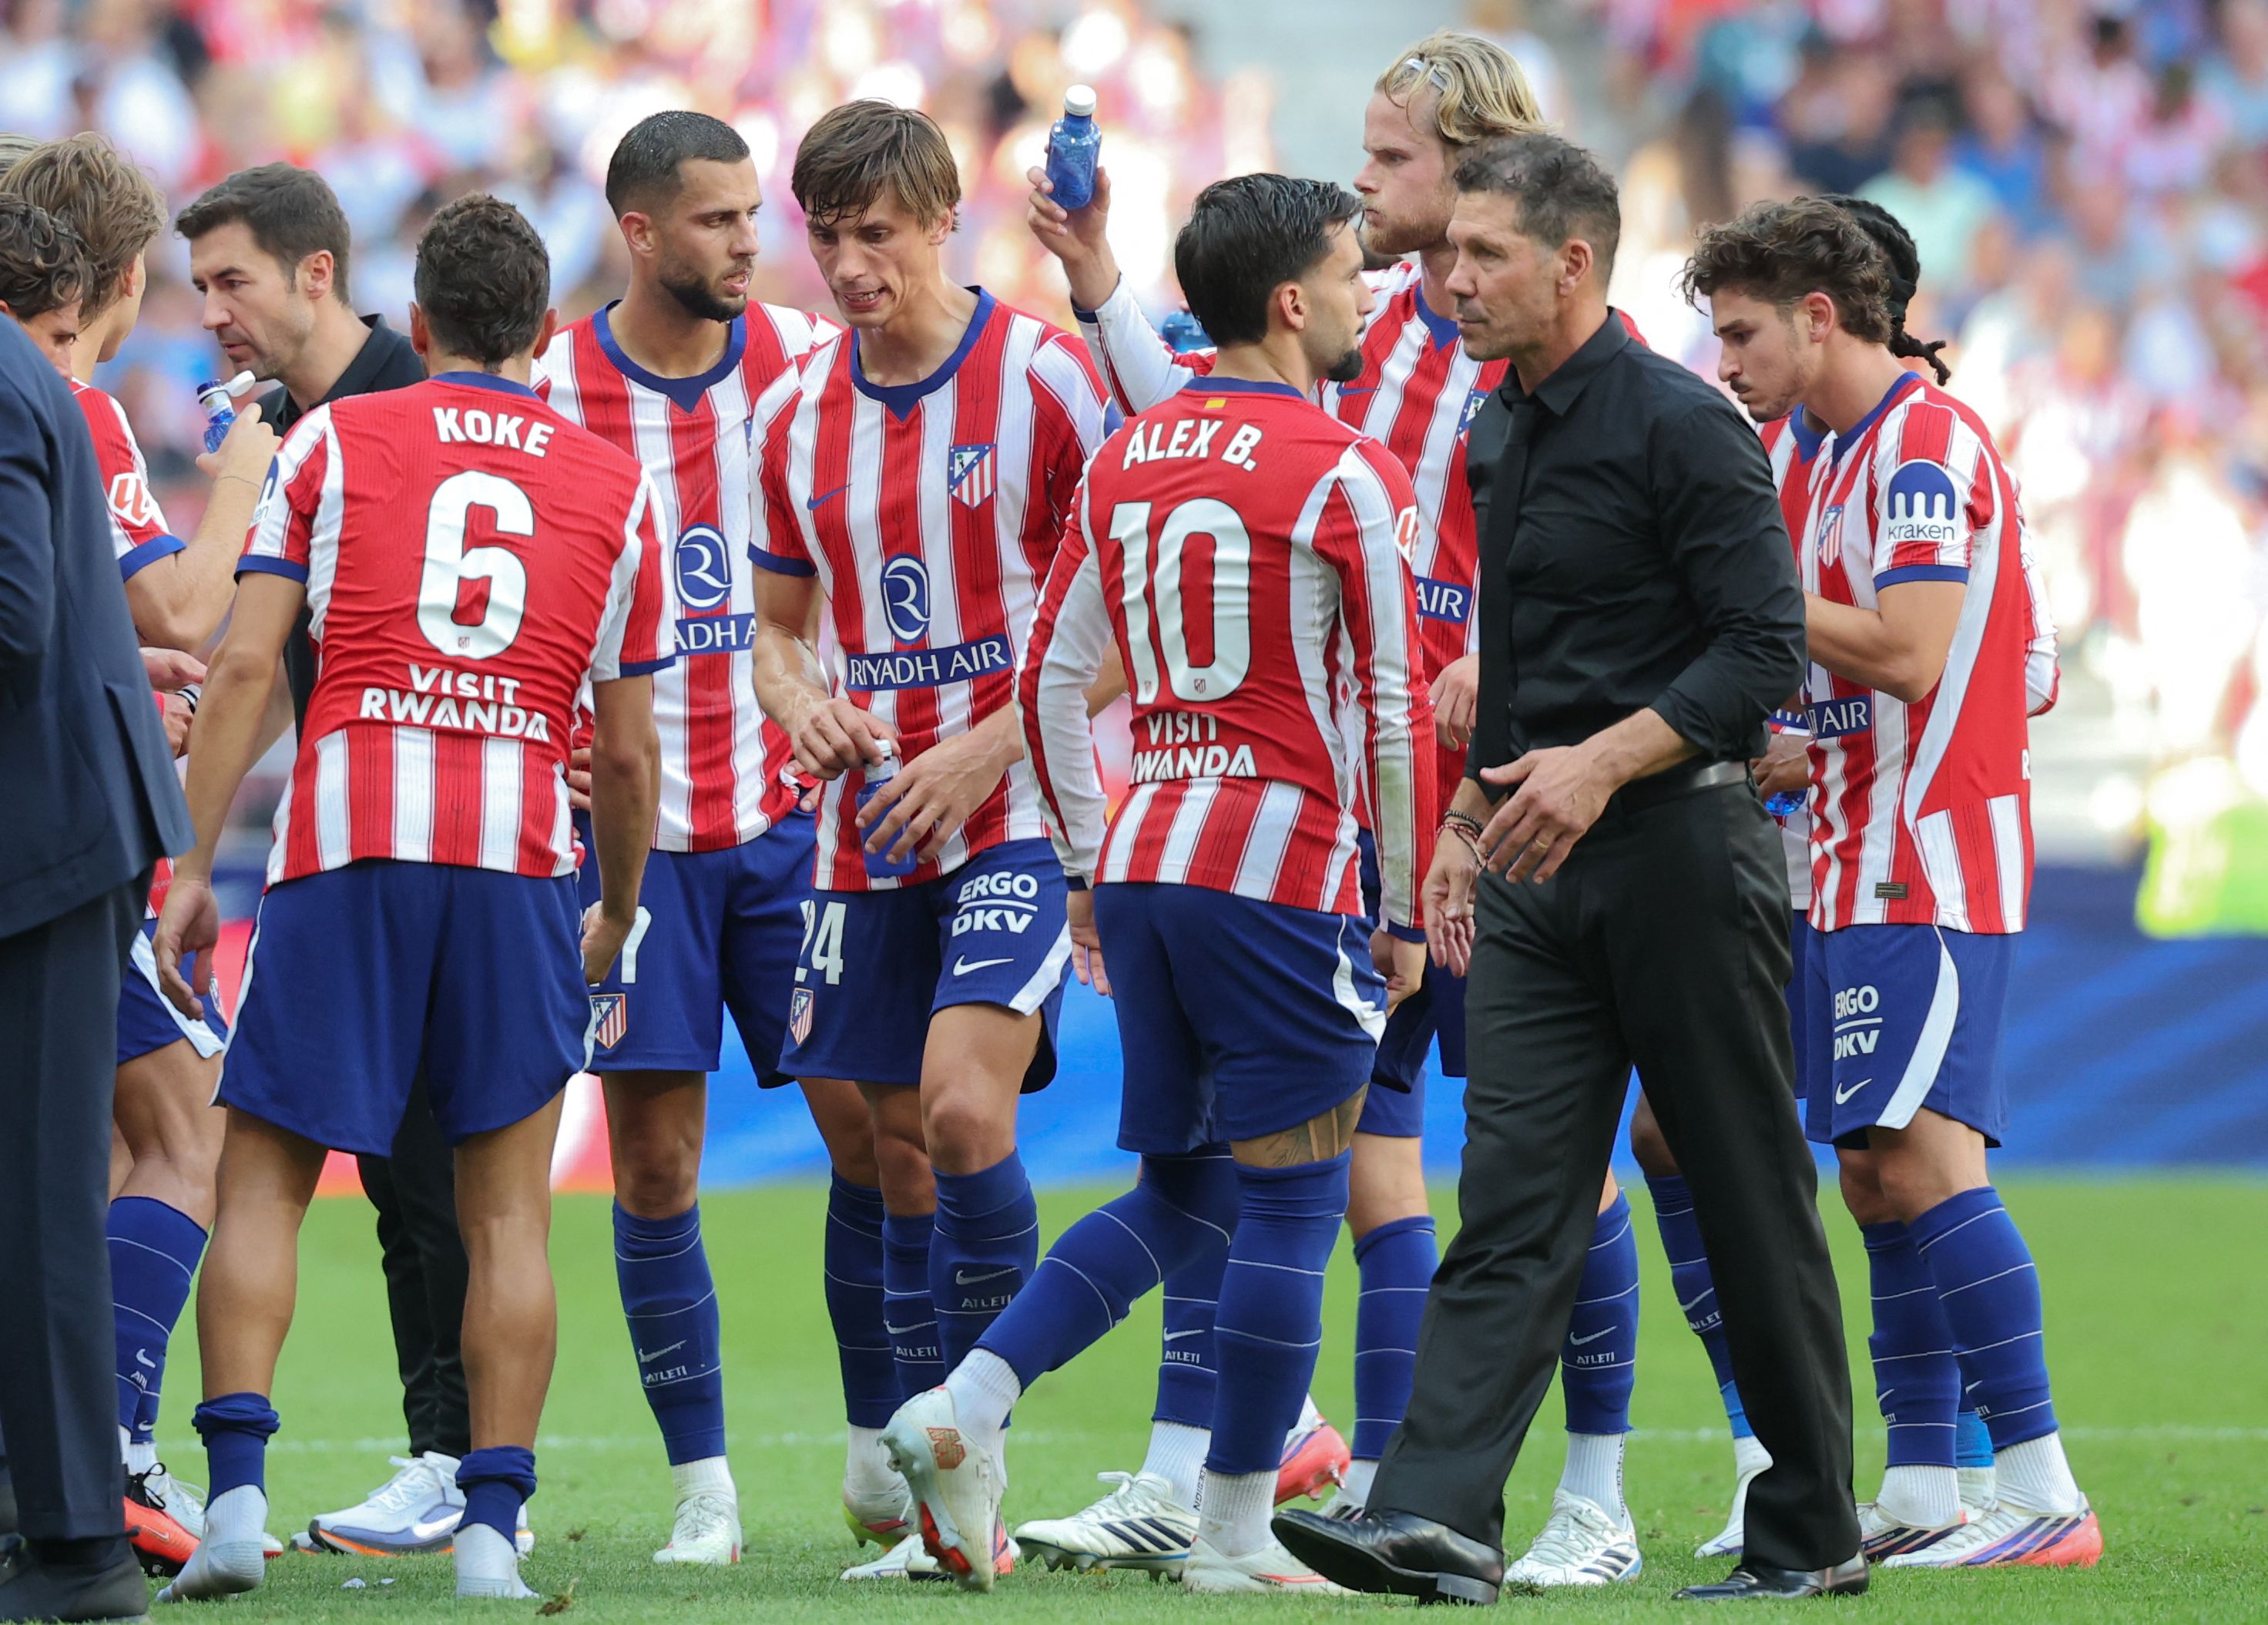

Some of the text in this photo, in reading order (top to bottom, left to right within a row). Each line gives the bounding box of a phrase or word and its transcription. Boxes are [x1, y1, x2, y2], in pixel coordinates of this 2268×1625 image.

[432, 407, 555, 458] KOKE
[1122, 418, 1263, 472] ÁLEX B.
[1887, 524, 1954, 540] kraken
[416, 469, 535, 660] 6
[1109, 497, 1251, 704] 10
[1416, 582, 1463, 619] AIR
[675, 619, 737, 650] ADH
[850, 640, 1007, 686] RIYADH AIR
[408, 663, 521, 706] VISIT
[359, 687, 550, 743] RWANDA
[1146, 710, 1217, 746] VISIT
[1822, 701, 1867, 733] AIR
[1130, 744, 1257, 784] WANDA
[957, 871, 1038, 903] ERGO
[951, 909, 1033, 937] DKV
[1835, 985, 1879, 1020] ERGO
[1834, 1029, 1880, 1061] DKV
[961, 1294, 1012, 1308] ATLETI
[1689, 1310, 1721, 1329] ATLET
[896, 1346, 938, 1357] ATLETI
[1165, 1350, 1200, 1364] ATLETI
[1577, 1351, 1615, 1365] ATLETI
[646, 1365, 687, 1384] ATLETI
